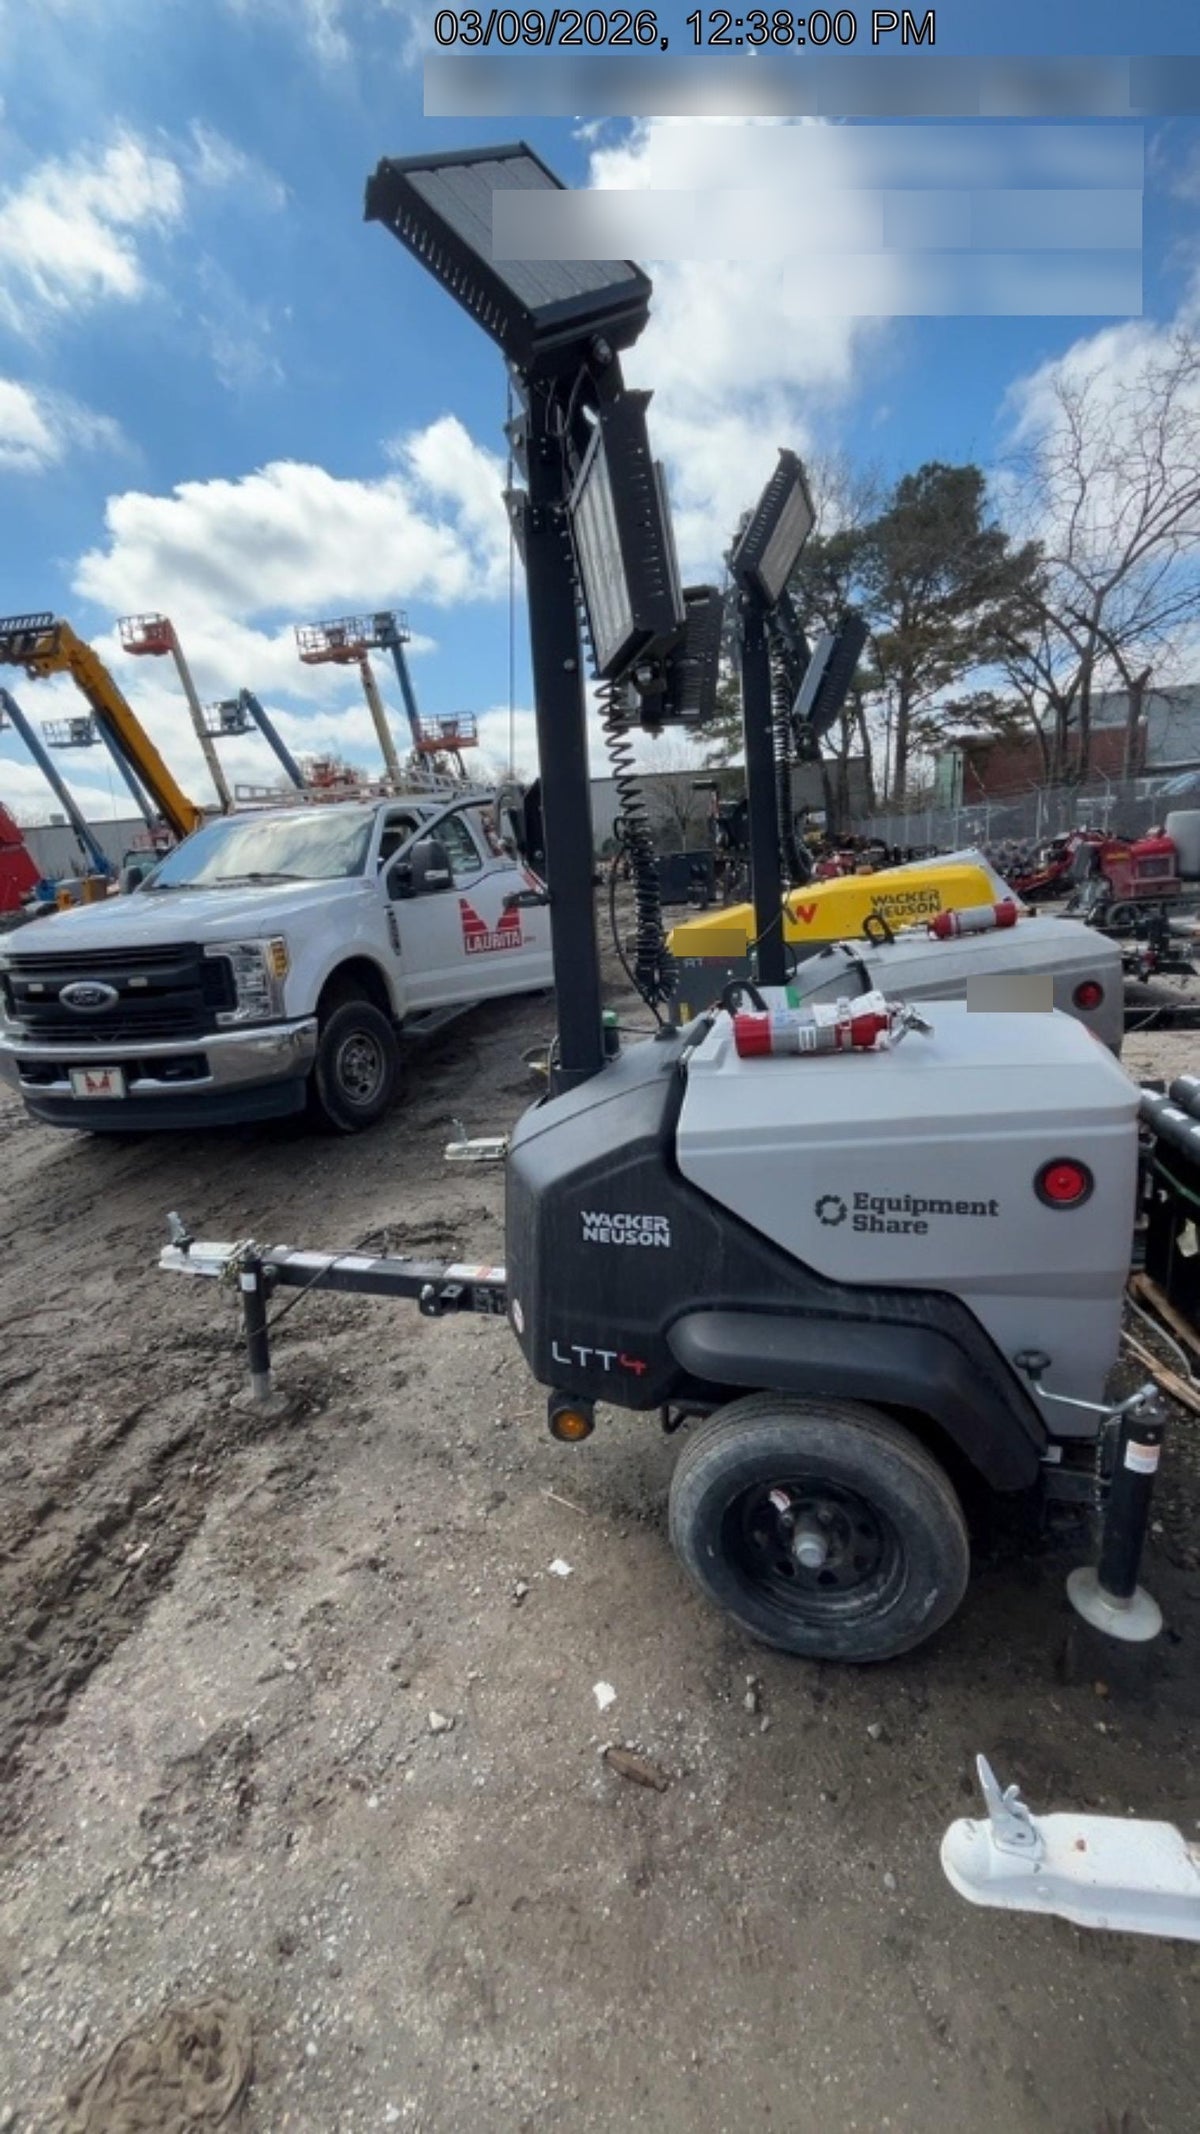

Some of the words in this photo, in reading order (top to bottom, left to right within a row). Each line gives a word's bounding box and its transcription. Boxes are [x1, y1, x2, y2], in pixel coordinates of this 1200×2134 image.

[870, 889, 940, 906] WACKER
[872, 902, 941, 917] NEUSON
[466, 930, 522, 952] LAURITA
[853, 1192, 999, 1216] Equipment
[580, 1211, 670, 1231] WACKER
[853, 1214, 928, 1234] Share
[583, 1227, 670, 1247] NEUSON
[552, 1341, 646, 1375] LTT4
